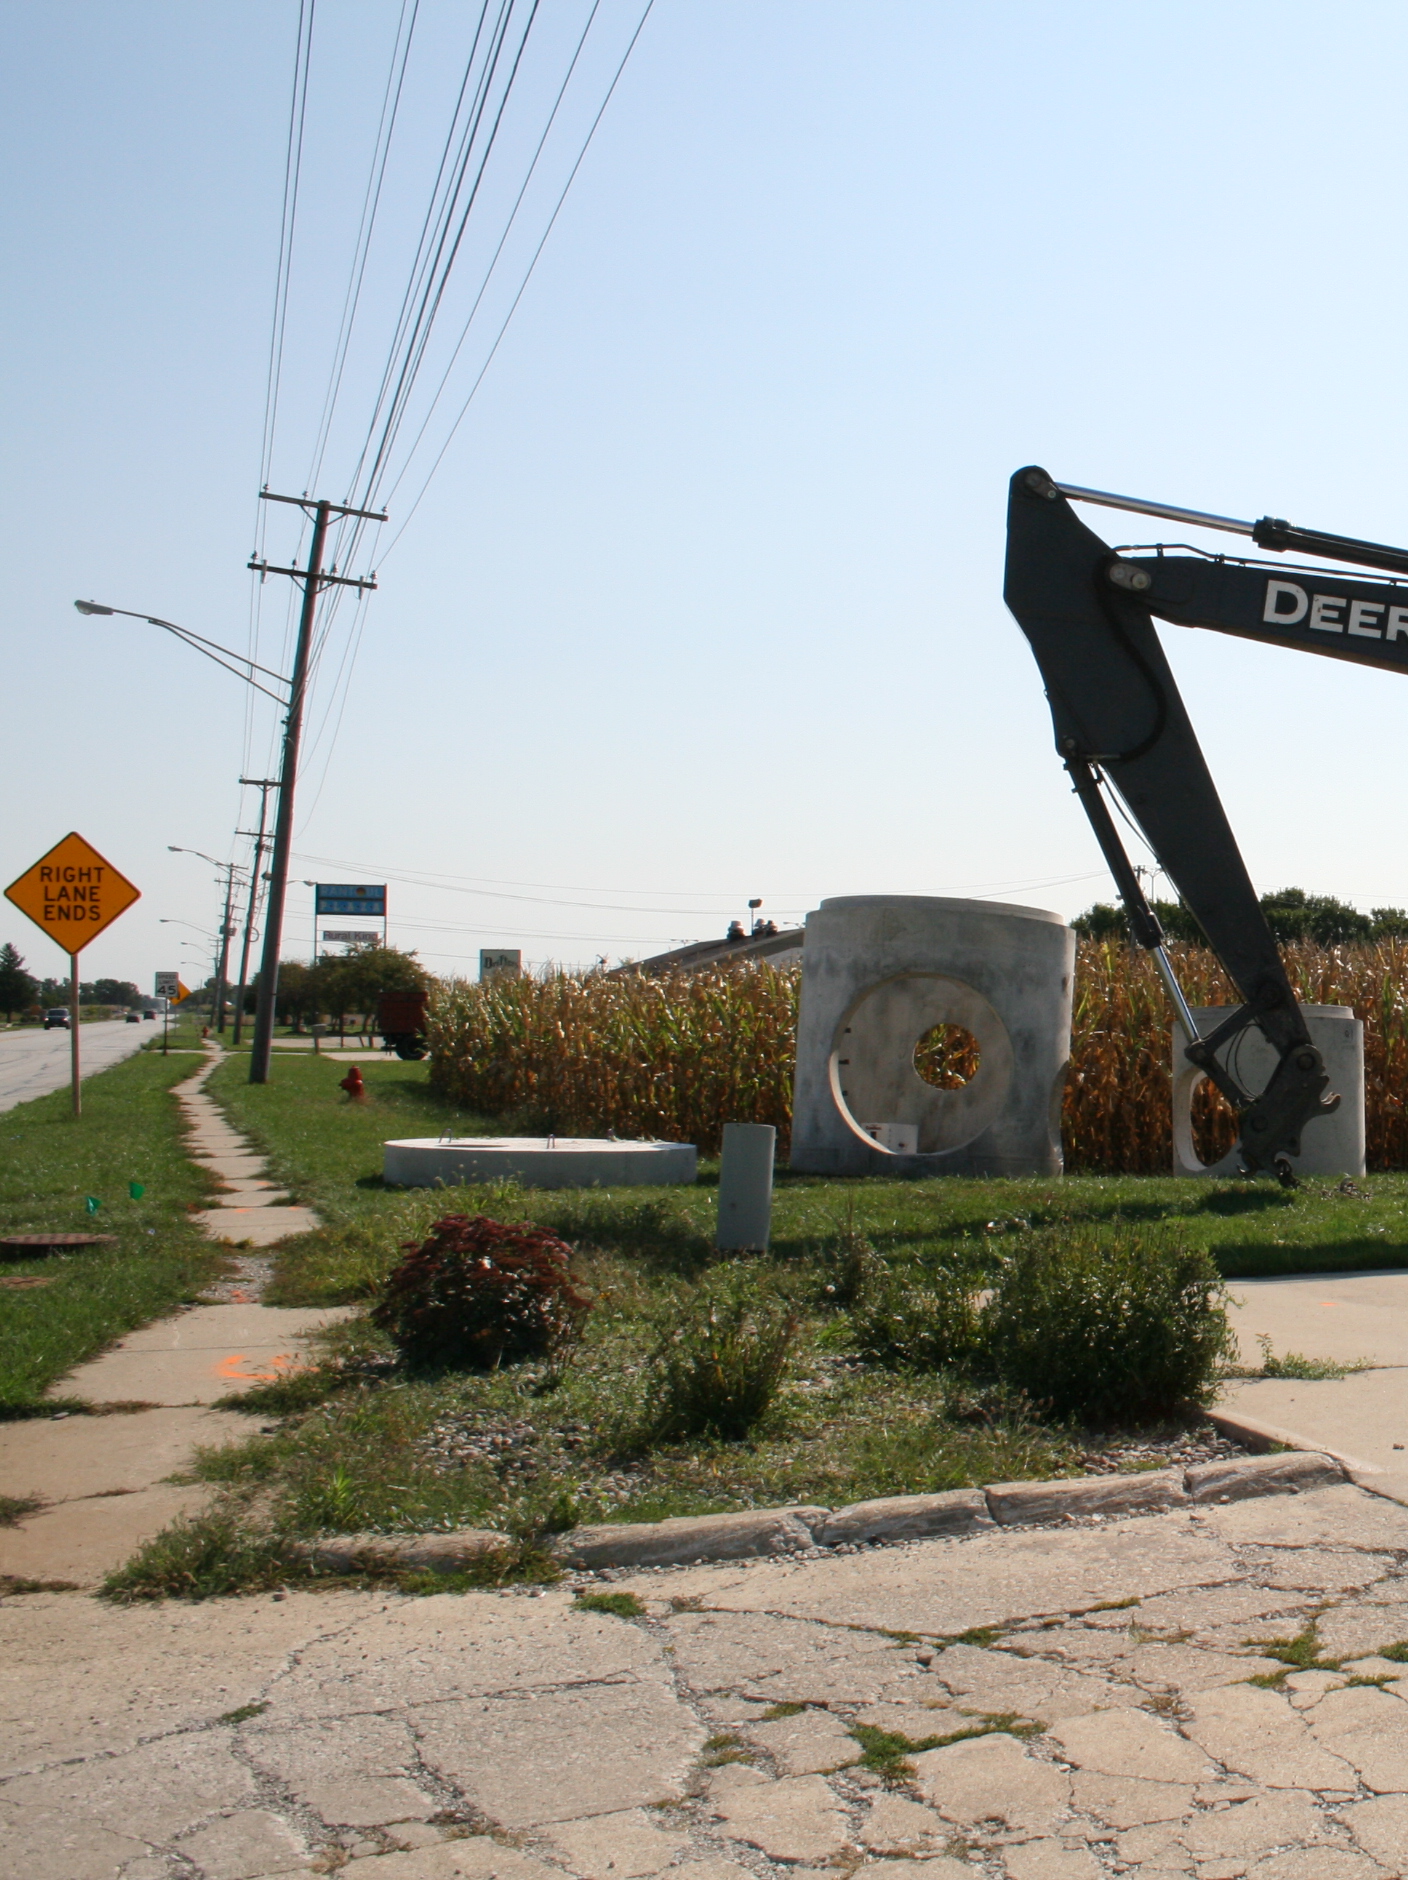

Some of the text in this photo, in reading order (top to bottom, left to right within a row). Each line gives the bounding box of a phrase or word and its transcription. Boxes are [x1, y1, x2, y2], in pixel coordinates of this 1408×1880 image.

[40, 866, 105, 883] RIGHT
[44, 886, 101, 902] LANE
[44, 904, 101, 921] ENDS
[324, 931, 378, 941] Rural King
[157, 985, 177, 995] 45
